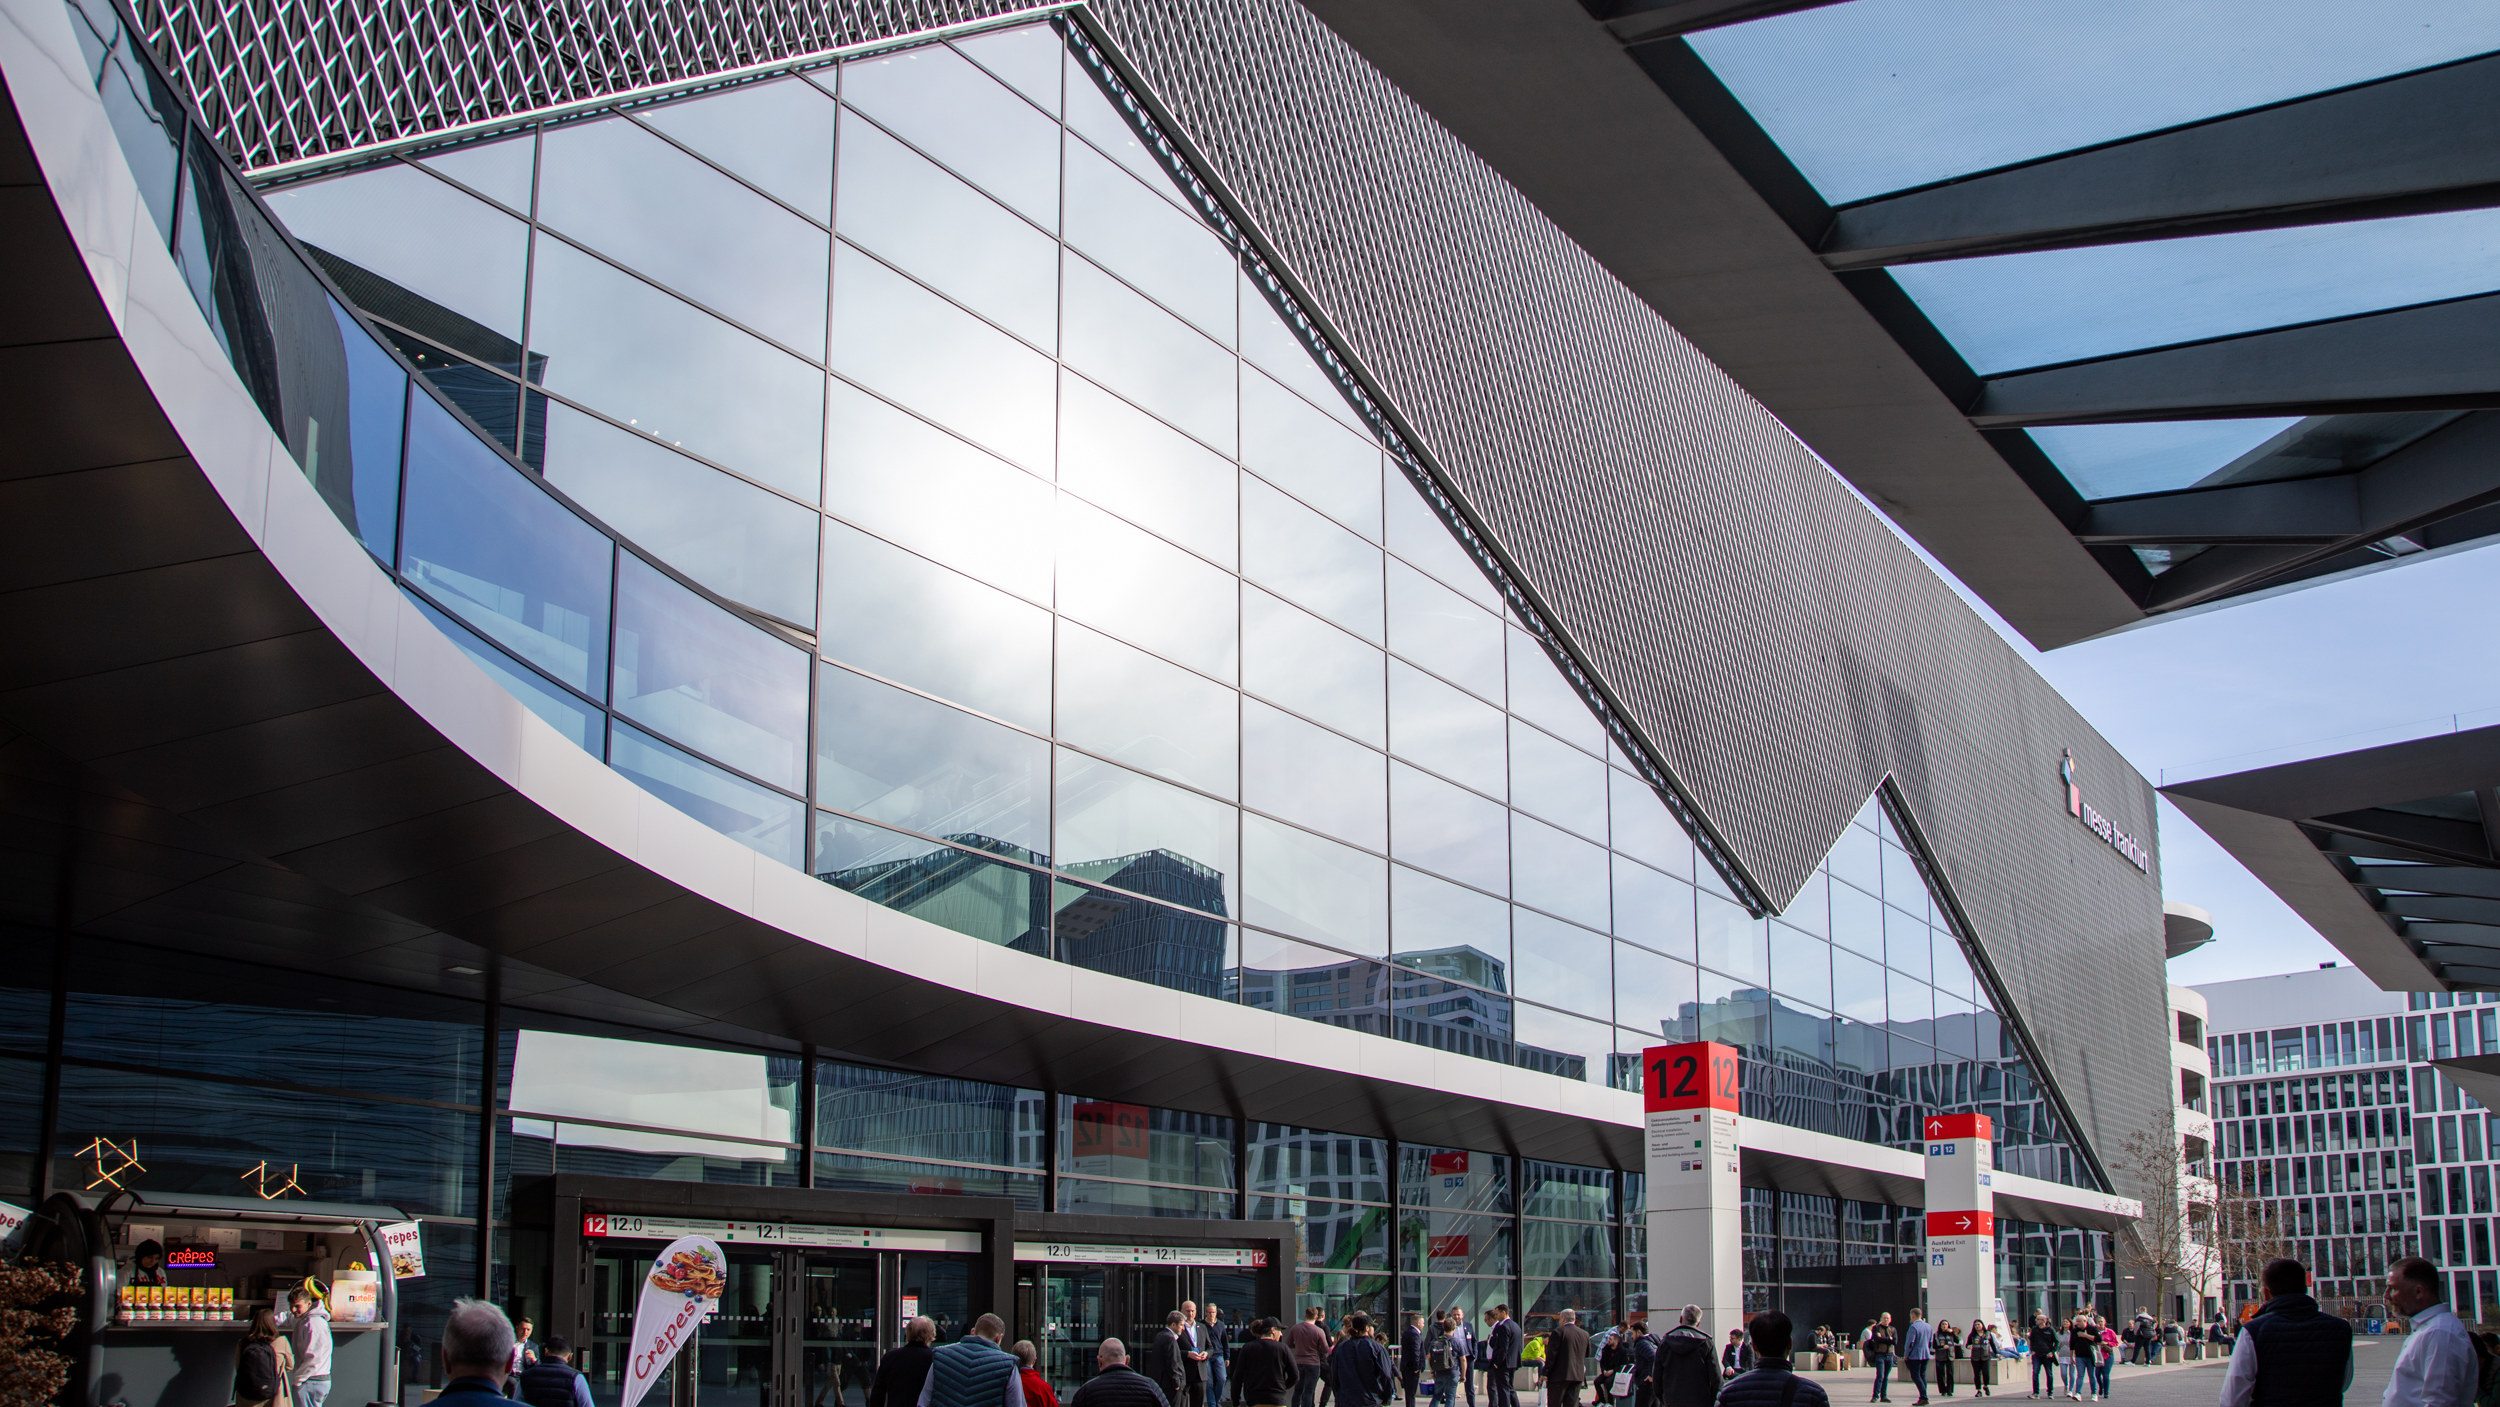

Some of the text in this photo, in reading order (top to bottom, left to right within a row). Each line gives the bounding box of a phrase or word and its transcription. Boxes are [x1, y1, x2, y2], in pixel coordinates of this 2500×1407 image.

[2083, 802, 2149, 874] messe frankfurt
[1651, 1056, 1699, 1099] 12
[1713, 1056, 1735, 1099] 12
[1932, 1146, 1938, 1155] P
[586, 1216, 606, 1233] 12
[611, 1217, 643, 1231] 12.0
[756, 1224, 784, 1239] 12.1
[1047, 1245, 1071, 1257] 12.0
[1156, 1248, 1177, 1260] 12.1
[1253, 1251, 1266, 1264] 12
[2370, 1319, 2379, 1328] P
[634, 1300, 697, 1380] Crêpes
